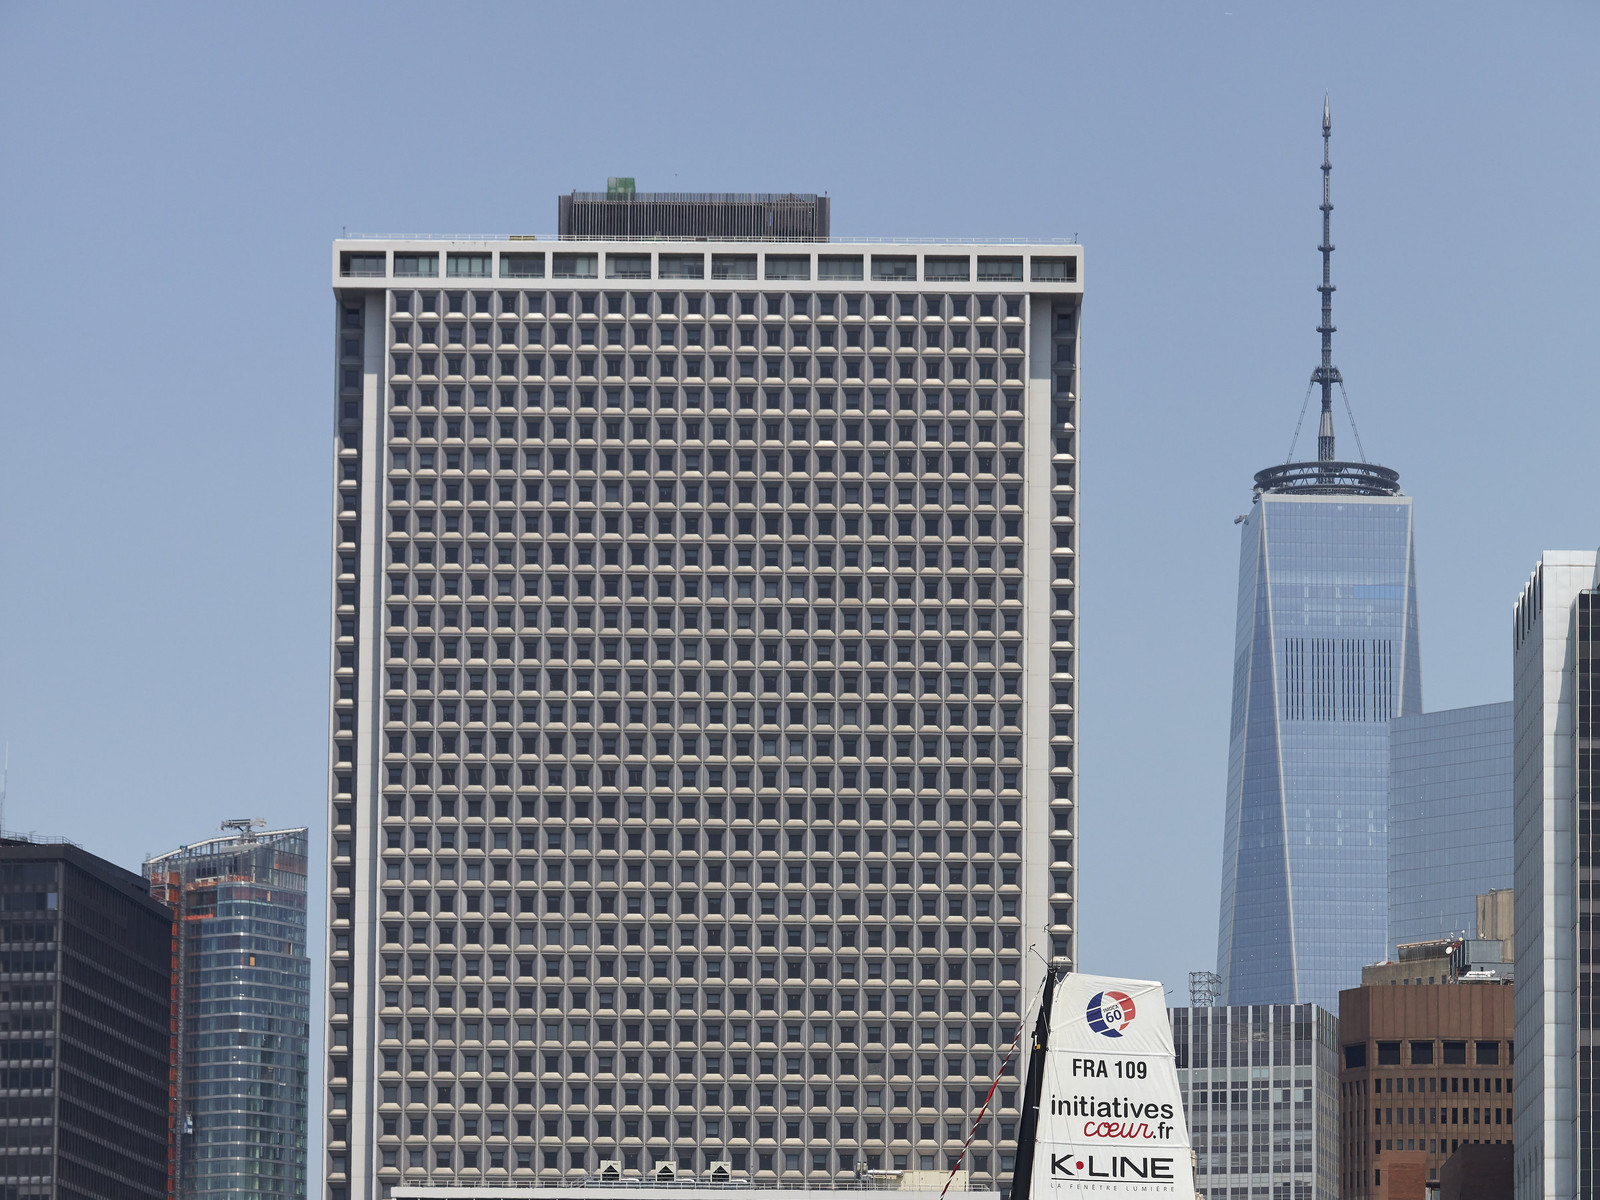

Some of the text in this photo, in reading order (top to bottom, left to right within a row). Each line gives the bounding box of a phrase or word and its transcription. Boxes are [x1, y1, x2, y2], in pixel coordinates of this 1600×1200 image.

[1105, 1010, 1122, 1023] 60
[1072, 1059, 1147, 1079] FRA 109
[1051, 1094, 1174, 1119] initiatives
